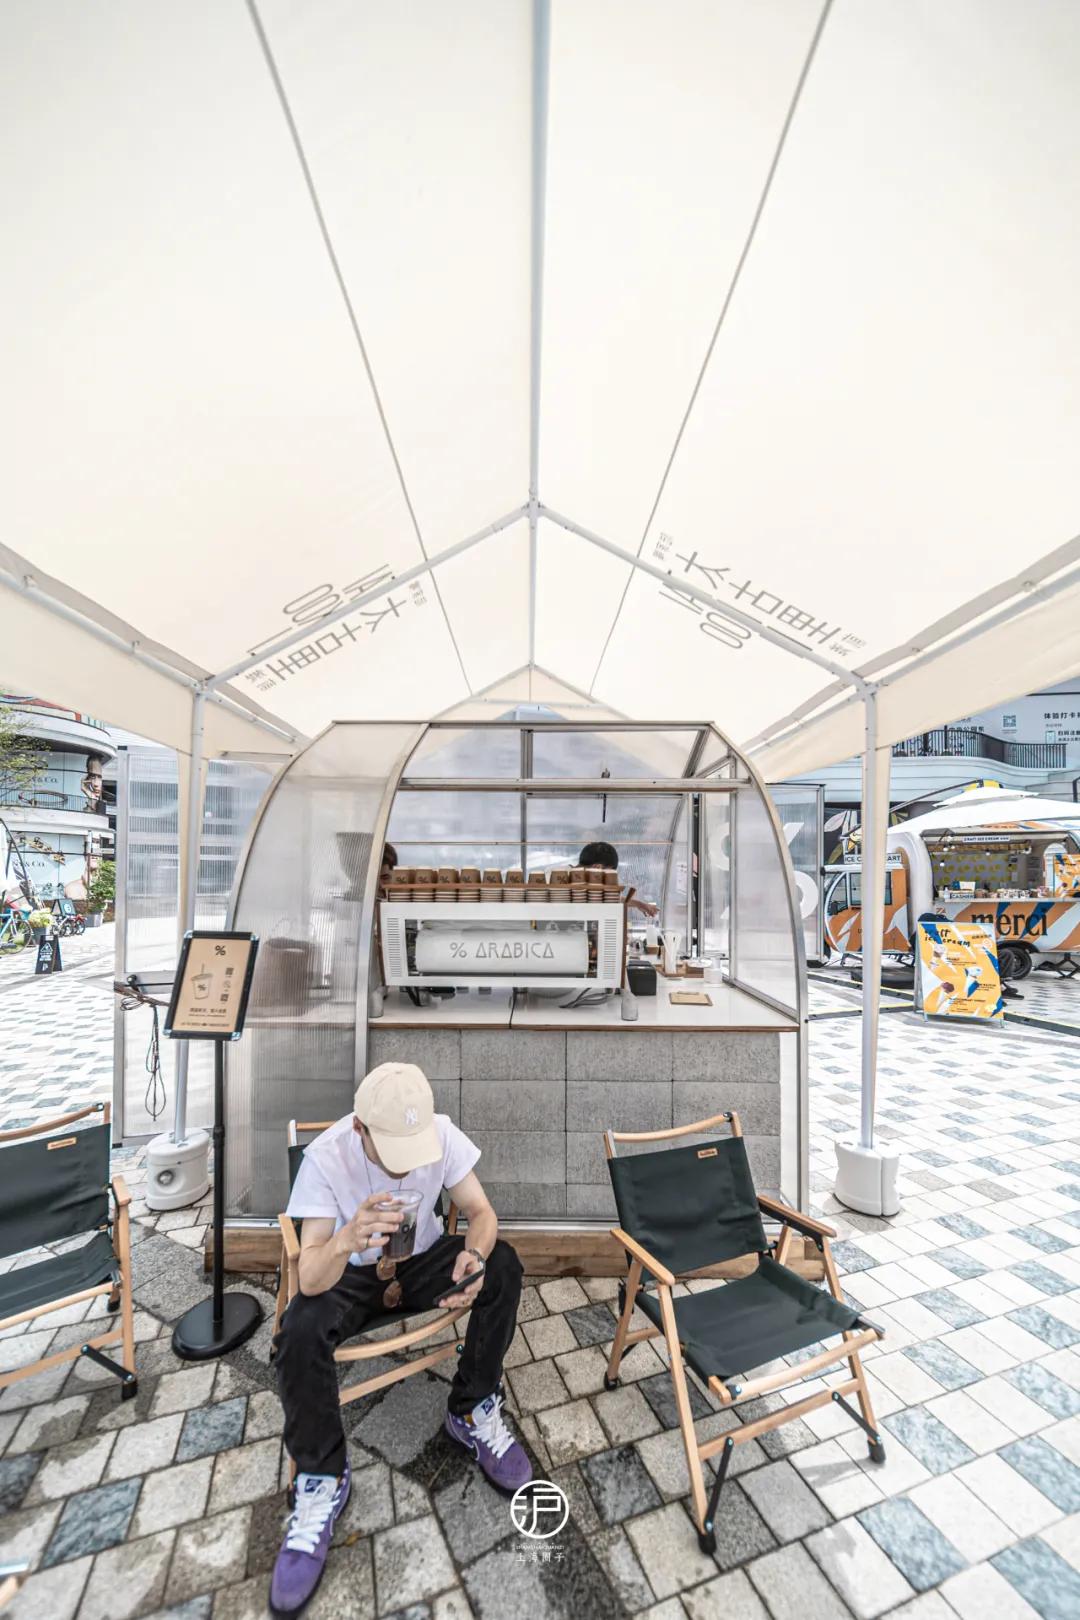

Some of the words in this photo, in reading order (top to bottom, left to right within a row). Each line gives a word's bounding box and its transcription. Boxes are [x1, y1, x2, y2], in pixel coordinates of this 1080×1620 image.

[214, 944, 227, 957] %
[449, 942, 468, 959] %
[475, 942, 555, 959] ARABICA
